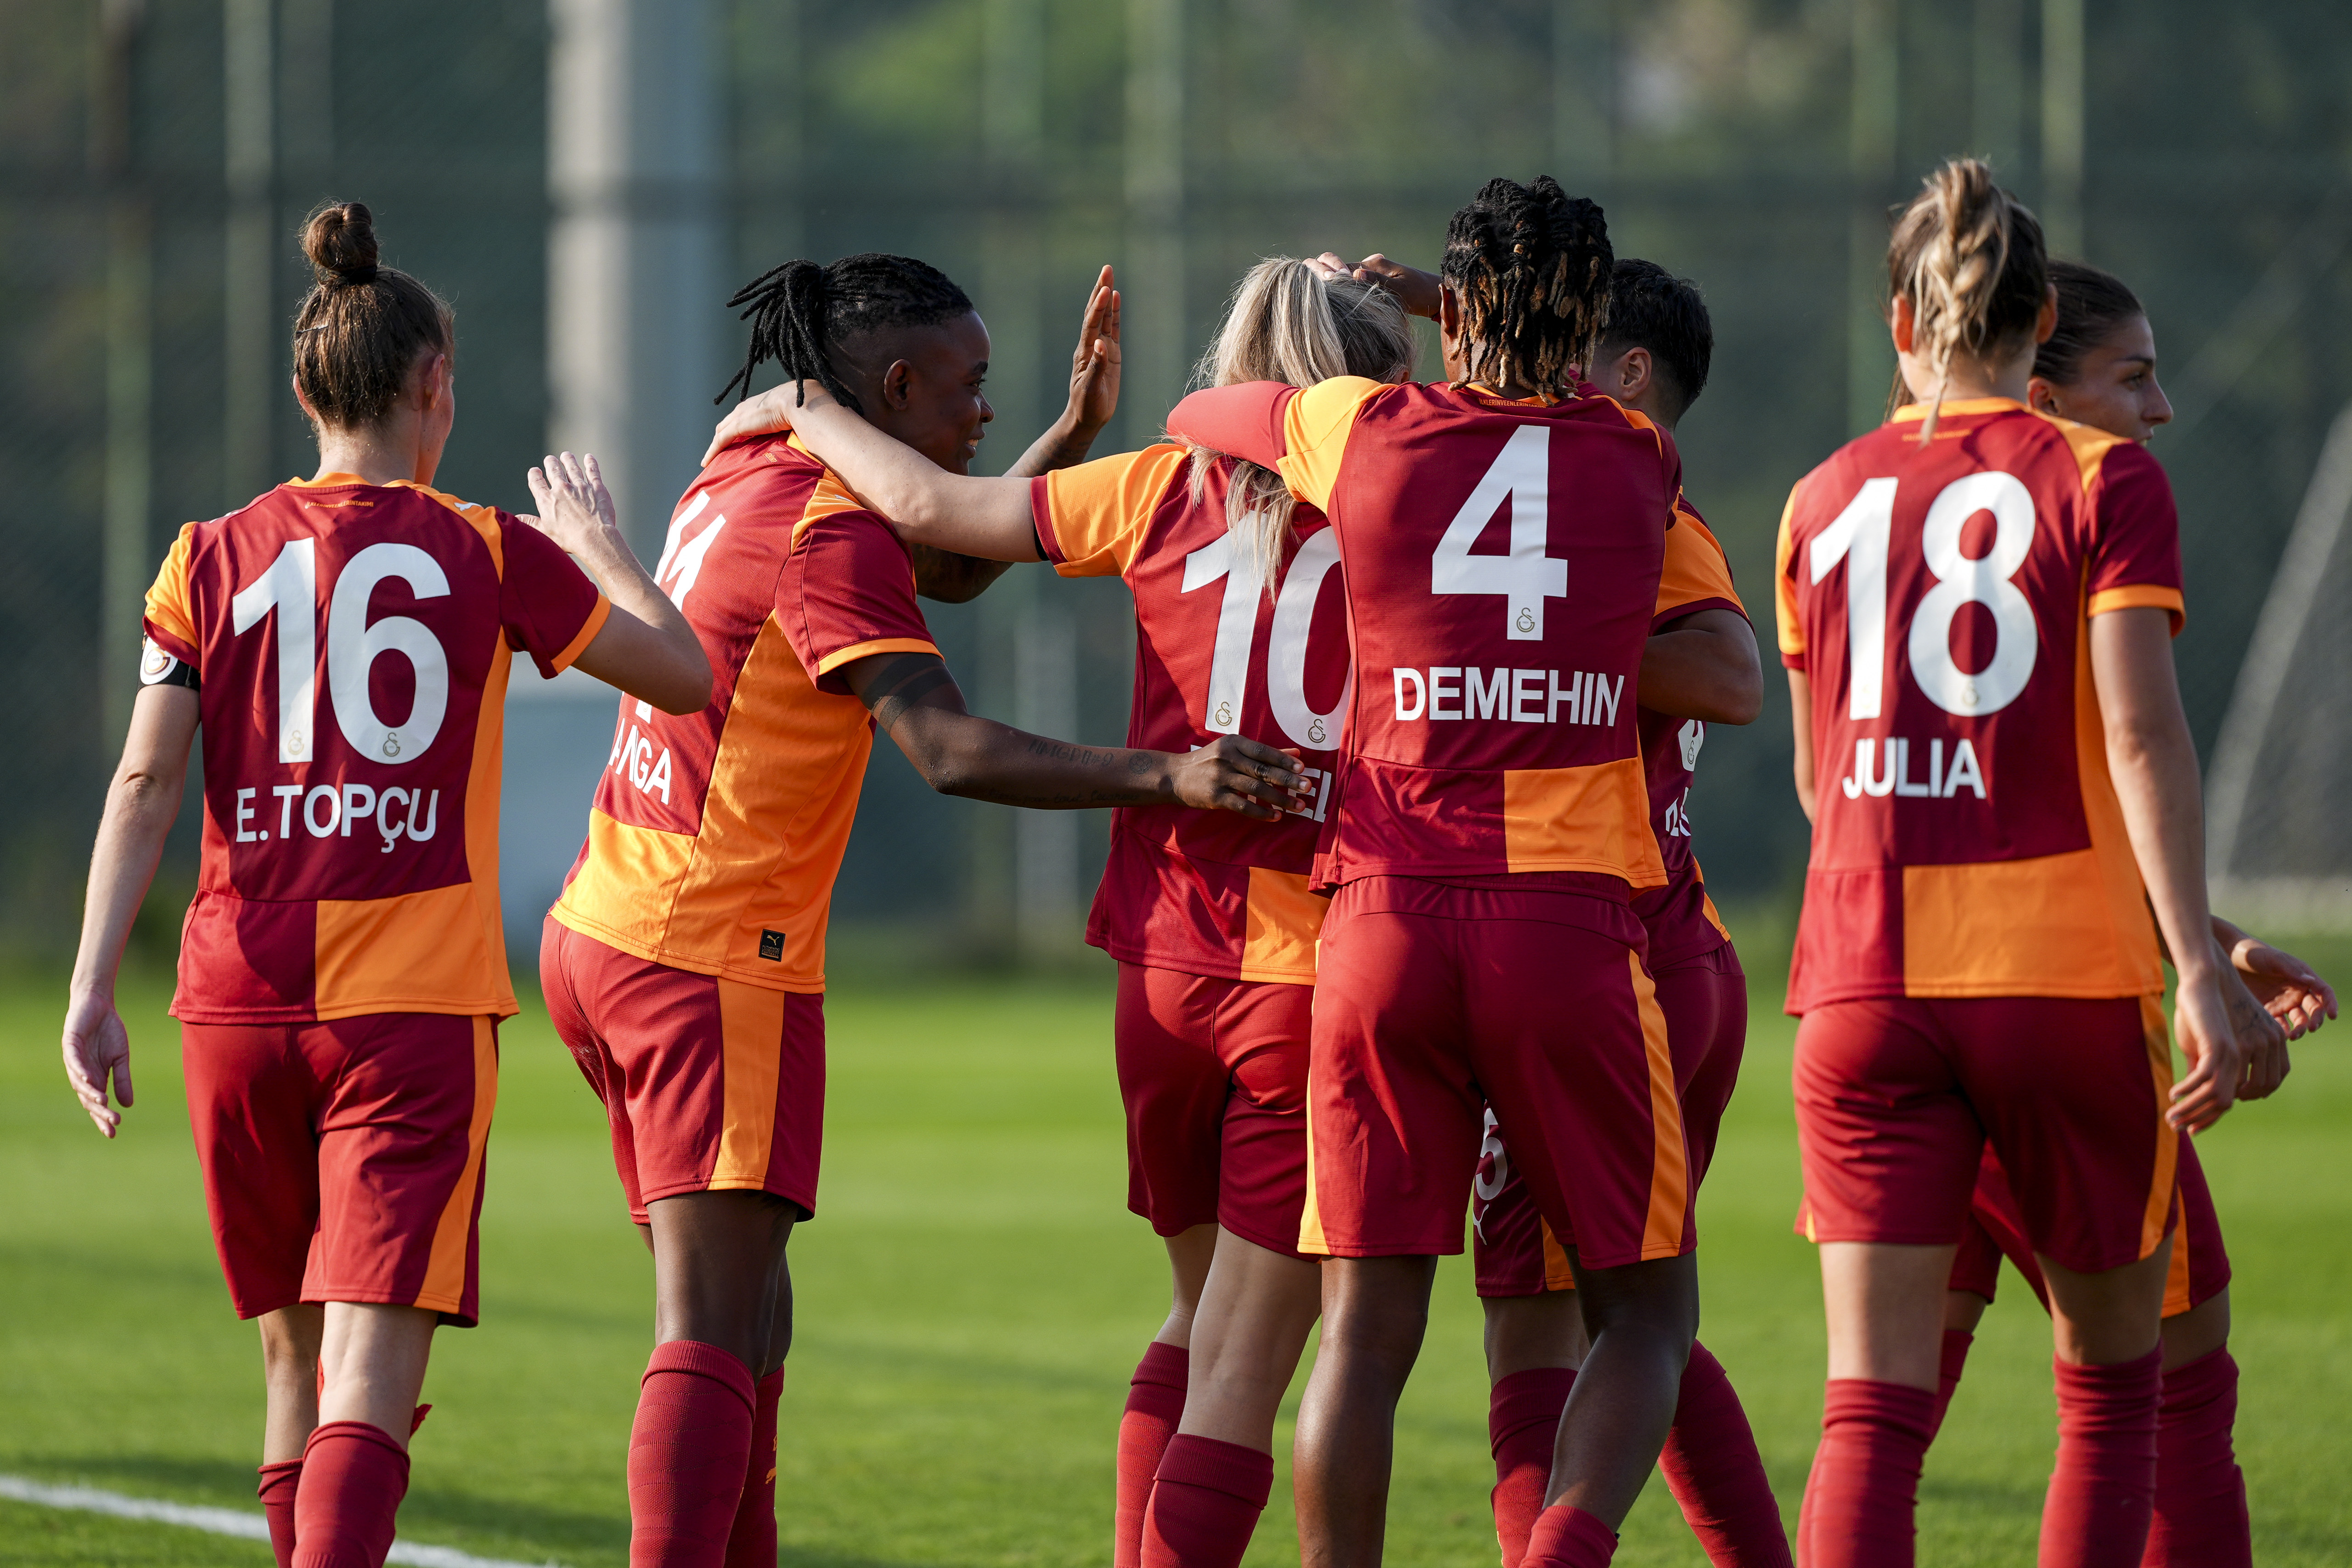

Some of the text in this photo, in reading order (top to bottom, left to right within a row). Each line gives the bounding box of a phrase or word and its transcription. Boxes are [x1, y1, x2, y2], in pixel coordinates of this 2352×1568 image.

[1181, 510, 1353, 751] 10
[1431, 425, 1568, 641] 4
[1809, 471, 2038, 720] 18
[232, 536, 451, 764] 16
[1393, 667, 1625, 727] DEMEHIN
[236, 783, 439, 853] E.TOPÇU
[1841, 737, 1986, 799] JULIA
